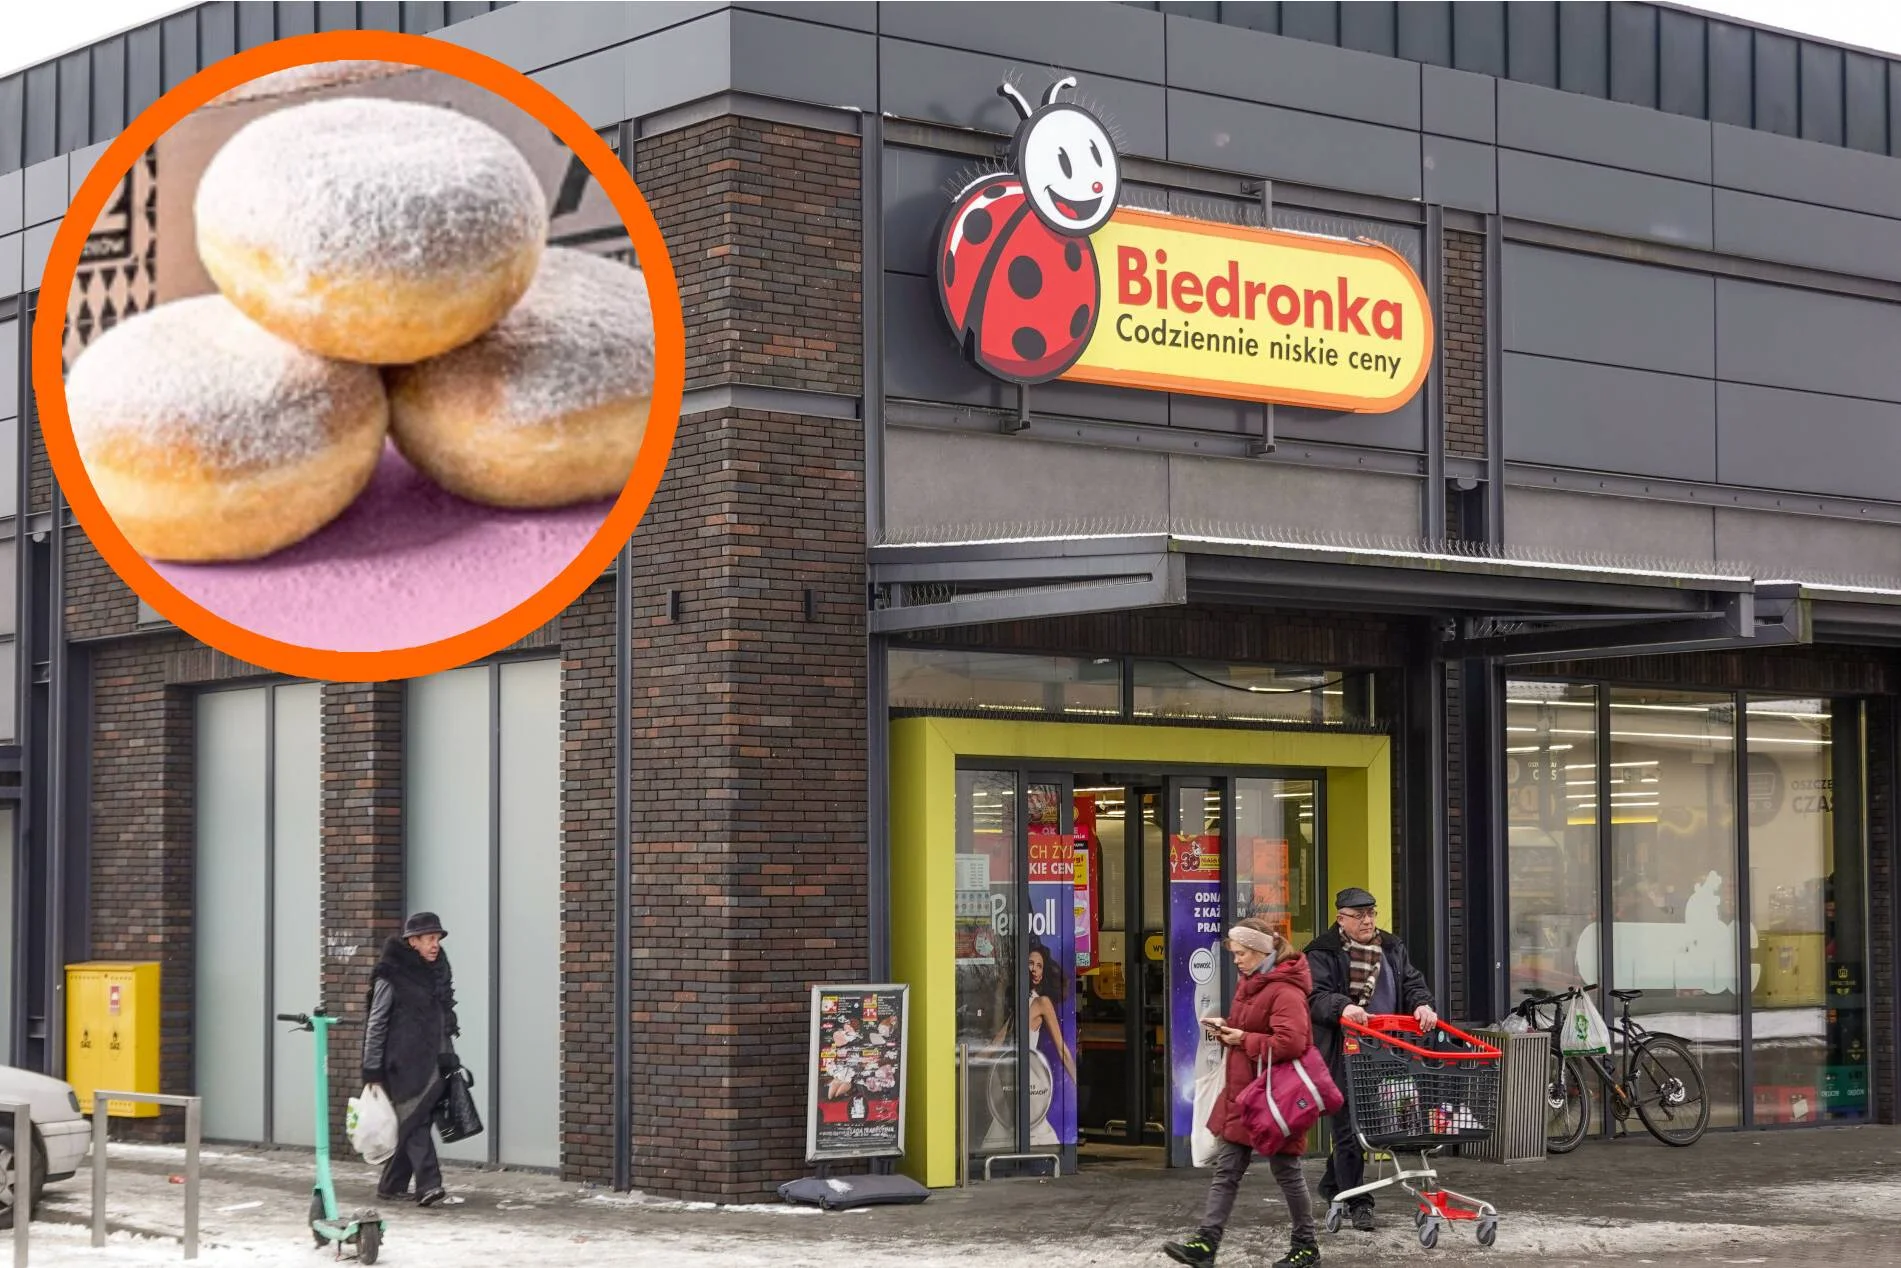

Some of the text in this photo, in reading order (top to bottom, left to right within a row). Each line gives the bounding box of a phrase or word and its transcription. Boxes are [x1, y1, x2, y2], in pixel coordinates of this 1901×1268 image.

[1117, 245, 1403, 341] Biedronka
[1115, 313, 1402, 379] Codziennie niskie ceny
[1792, 795, 1833, 814] CZA
[1029, 842, 1074, 859] CH ŻYJ
[1029, 863, 1074, 875] KIE CEN
[1194, 907, 1201, 918] Z
